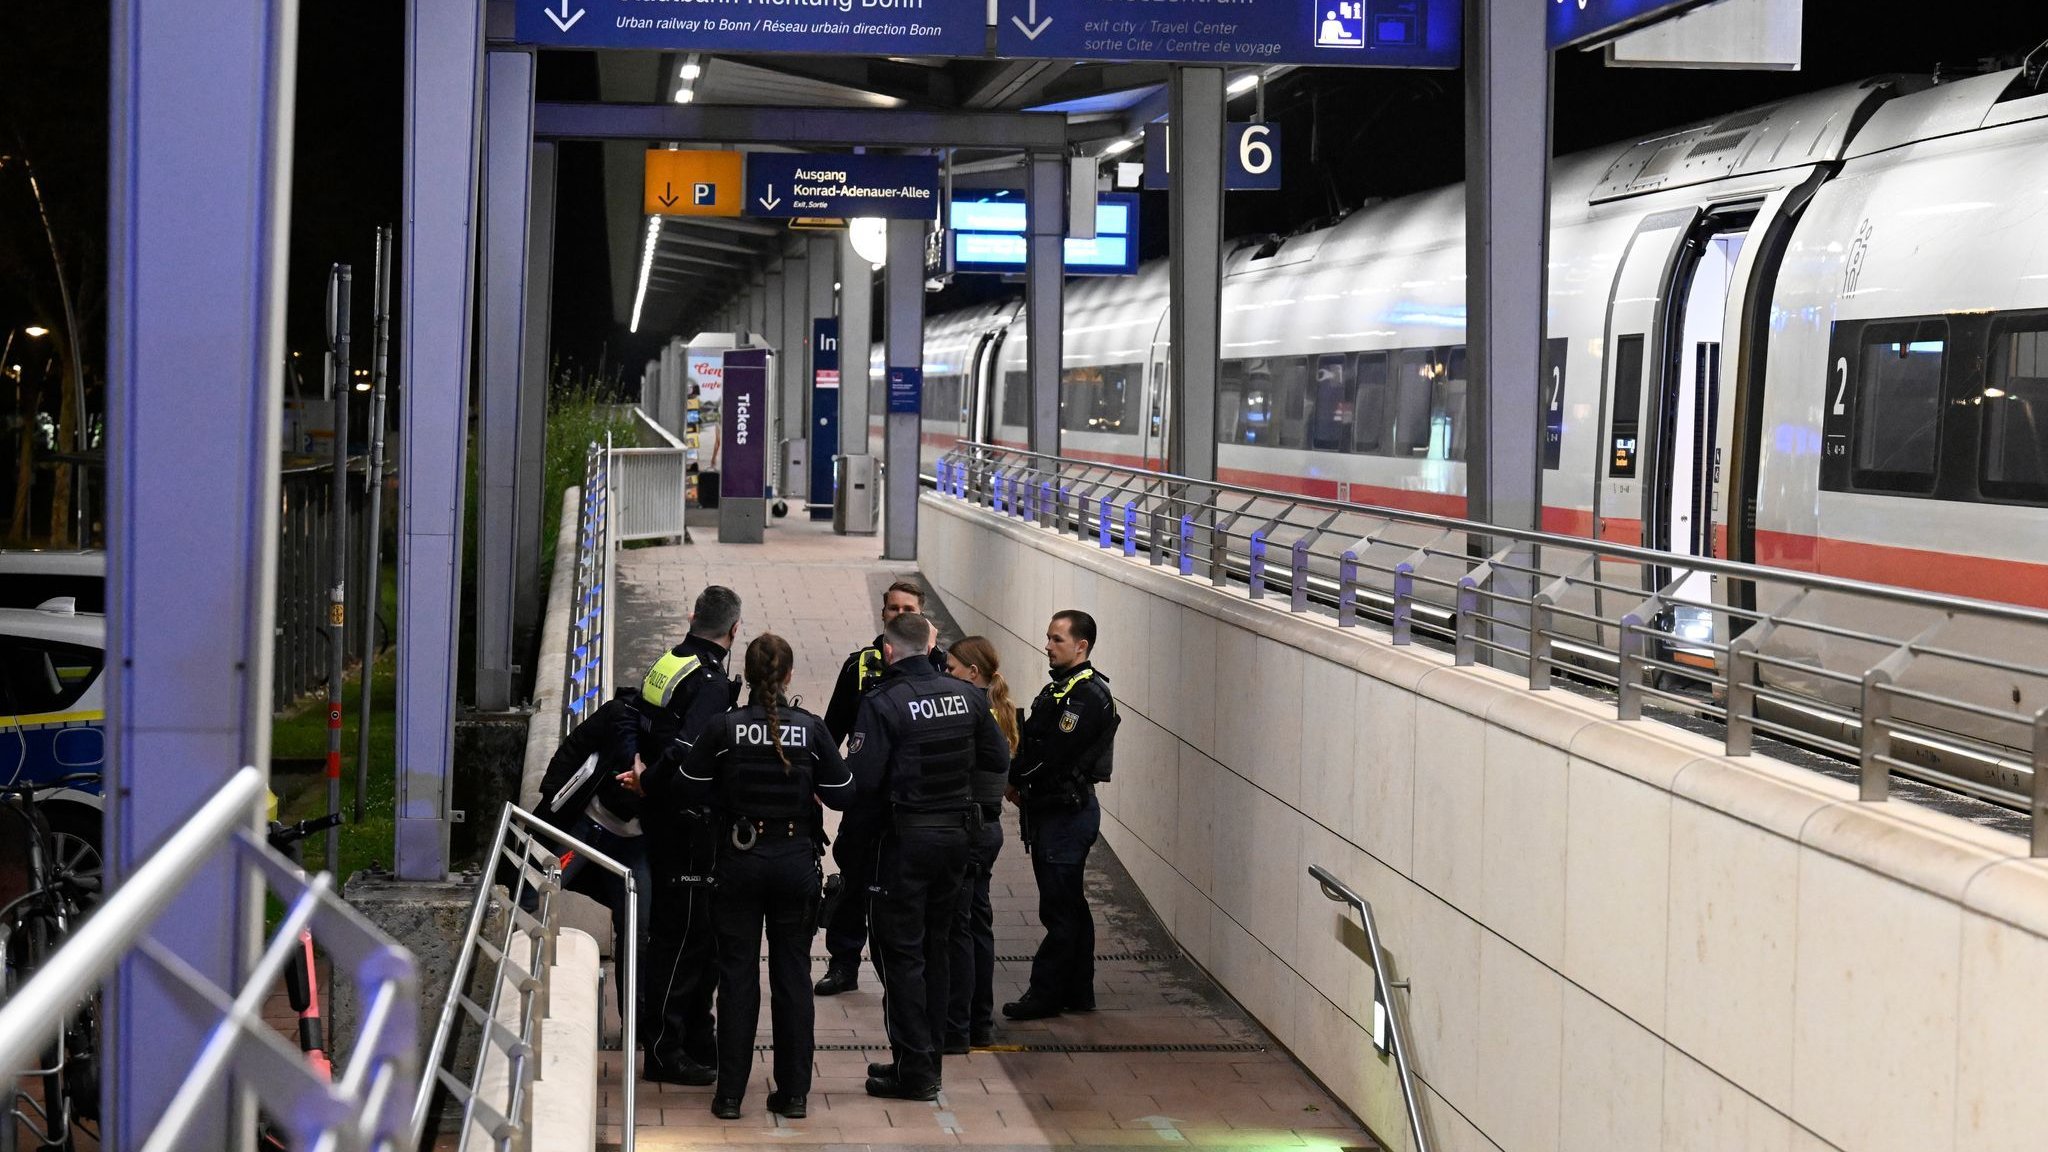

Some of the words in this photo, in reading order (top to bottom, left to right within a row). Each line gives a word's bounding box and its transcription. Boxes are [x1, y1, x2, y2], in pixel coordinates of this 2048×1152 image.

[616, 17, 653, 28] Urban
[656, 18, 701, 32] railway
[703, 19, 716, 30] to
[718, 19, 751, 31] Bonn
[753, 19, 761, 32] /
[762, 19, 808, 33] Réseau
[810, 21, 850, 34] urbain
[852, 23, 907, 35] direction
[909, 24, 942, 36] Bonn
[1084, 20, 1109, 32] exit
[1112, 20, 1137, 35] city
[1149, 20, 1190, 34] Travel
[1193, 21, 1238, 35] Center
[1084, 38, 1123, 51] sortie
[1166, 39, 1211, 52] Centre
[1214, 40, 1231, 53] de
[1234, 43, 1281, 57] voyage
[1239, 125, 1273, 174] 6
[794, 168, 847, 183] Ausgang
[694, 184, 711, 205] P
[793, 184, 931, 198] Konrad-Adenauer-Allee
[808, 201, 828, 209] Sortie
[820, 333, 839, 351] In
[1550, 365, 1560, 411] 2
[1833, 356, 1848, 415] 2
[737, 393, 751, 445] Tickets
[908, 695, 970, 721] POLIZEI
[735, 723, 807, 747] POLZEI
